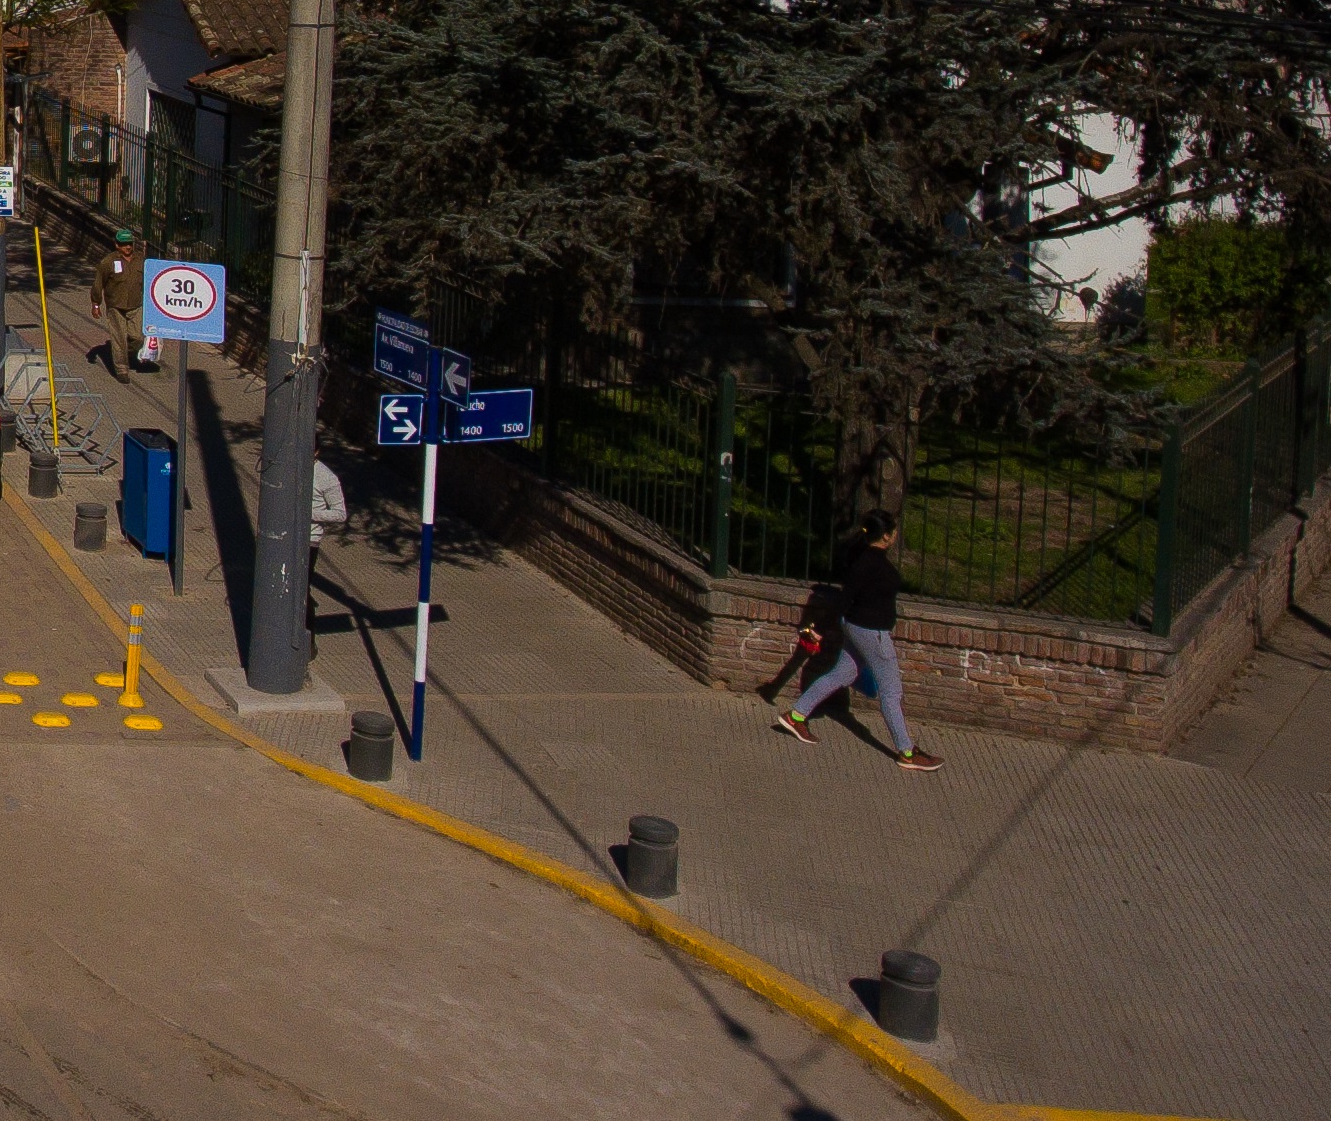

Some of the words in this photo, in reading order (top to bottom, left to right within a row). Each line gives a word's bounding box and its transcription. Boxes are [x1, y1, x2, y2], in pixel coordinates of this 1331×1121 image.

[171, 278, 195, 294] 30
[165, 294, 203, 308] km/h
[461, 425, 483, 436] 1400
[502, 423, 523, 434] 1500
